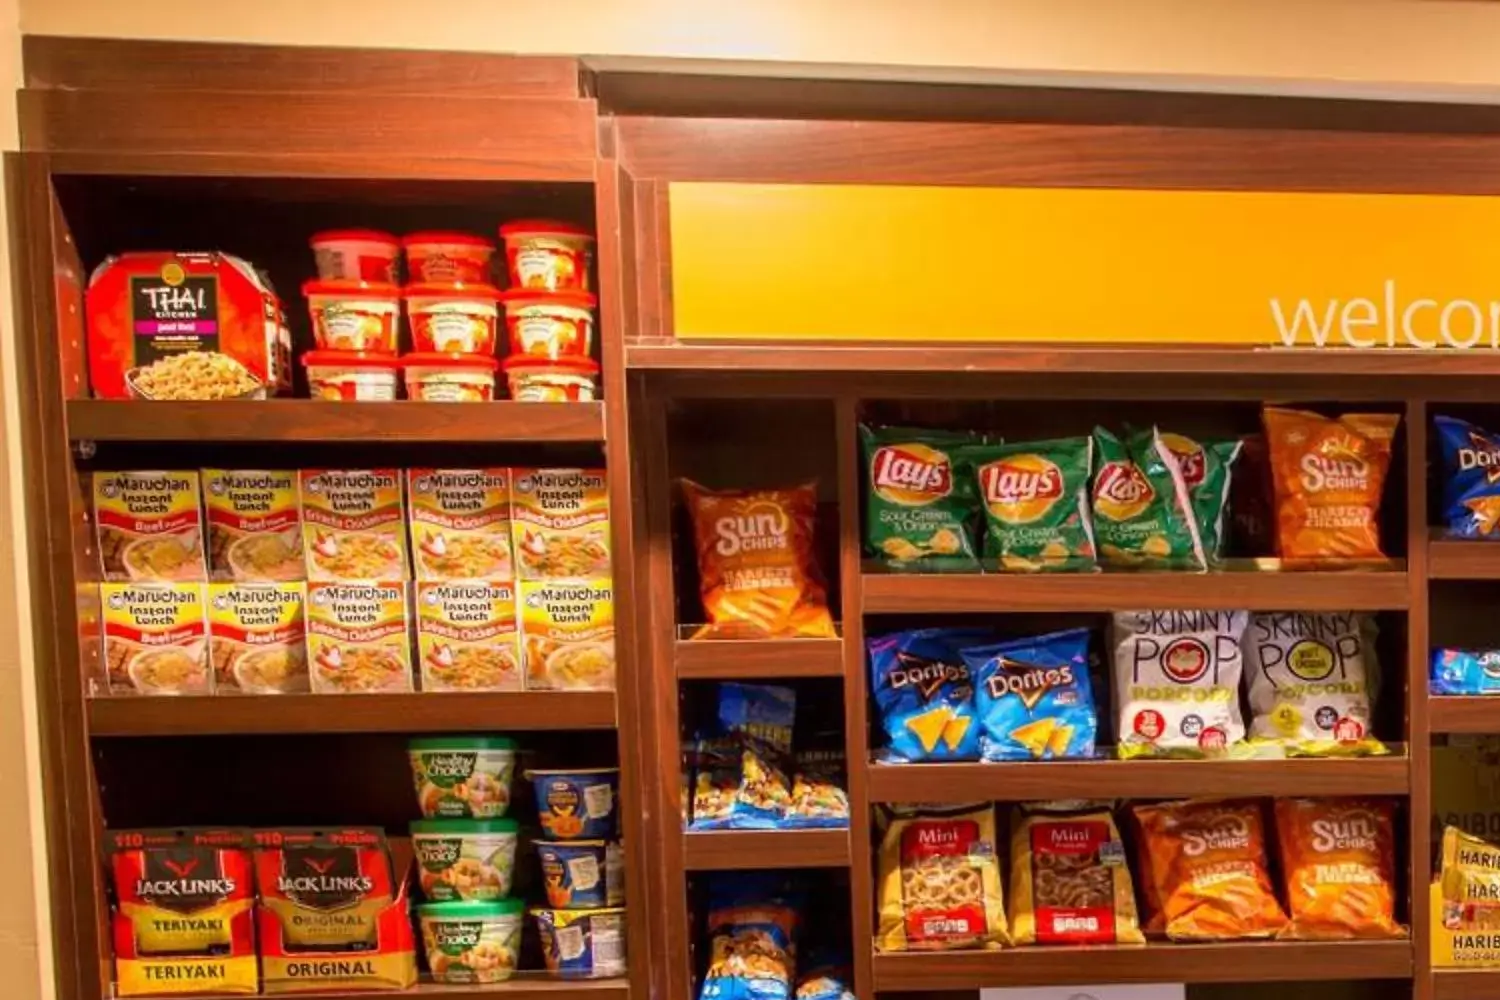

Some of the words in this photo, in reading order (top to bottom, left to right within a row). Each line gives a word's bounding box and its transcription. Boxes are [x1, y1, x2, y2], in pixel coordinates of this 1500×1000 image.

[142, 287, 205, 311] THAI
[116, 476, 190, 492] Maruchan
[221, 475, 291, 491] Maruchan
[320, 475, 393, 487] Maruchan
[429, 475, 502, 488] Maruchan
[531, 474, 600, 487] Maruchan
[715, 513, 788, 557] Sun
[741, 536, 787, 551] CHIPS
[122, 590, 196, 602] Maruchan
[227, 590, 300, 602] Maruchan
[326, 587, 397, 599] Maruchan
[437, 587, 509, 599] Maruchan
[541, 588, 611, 601] Maruchan
[1134, 609, 1237, 635] SKINNY
[1255, 611, 1352, 643] SKINNY
[1133, 635, 1239, 685] POP
[1258, 635, 1361, 689] POP
[890, 659, 970, 688] Doritos
[989, 664, 1074, 697] Doritos
[427, 763, 471, 777] Choice
[918, 828, 960, 844] Mini
[1049, 827, 1090, 843] Mini
[1312, 816, 1377, 853] Sun
[136, 879, 183, 896] JACK
[181, 877, 236, 895] LINK'S
[278, 876, 324, 892] JACK
[321, 876, 373, 891] LINK'S
[153, 919, 224, 932] TERIYAKI
[293, 915, 366, 927] ORIGINAL
[143, 965, 225, 980] TERIYAKI
[287, 961, 376, 977] ORIGINAL
